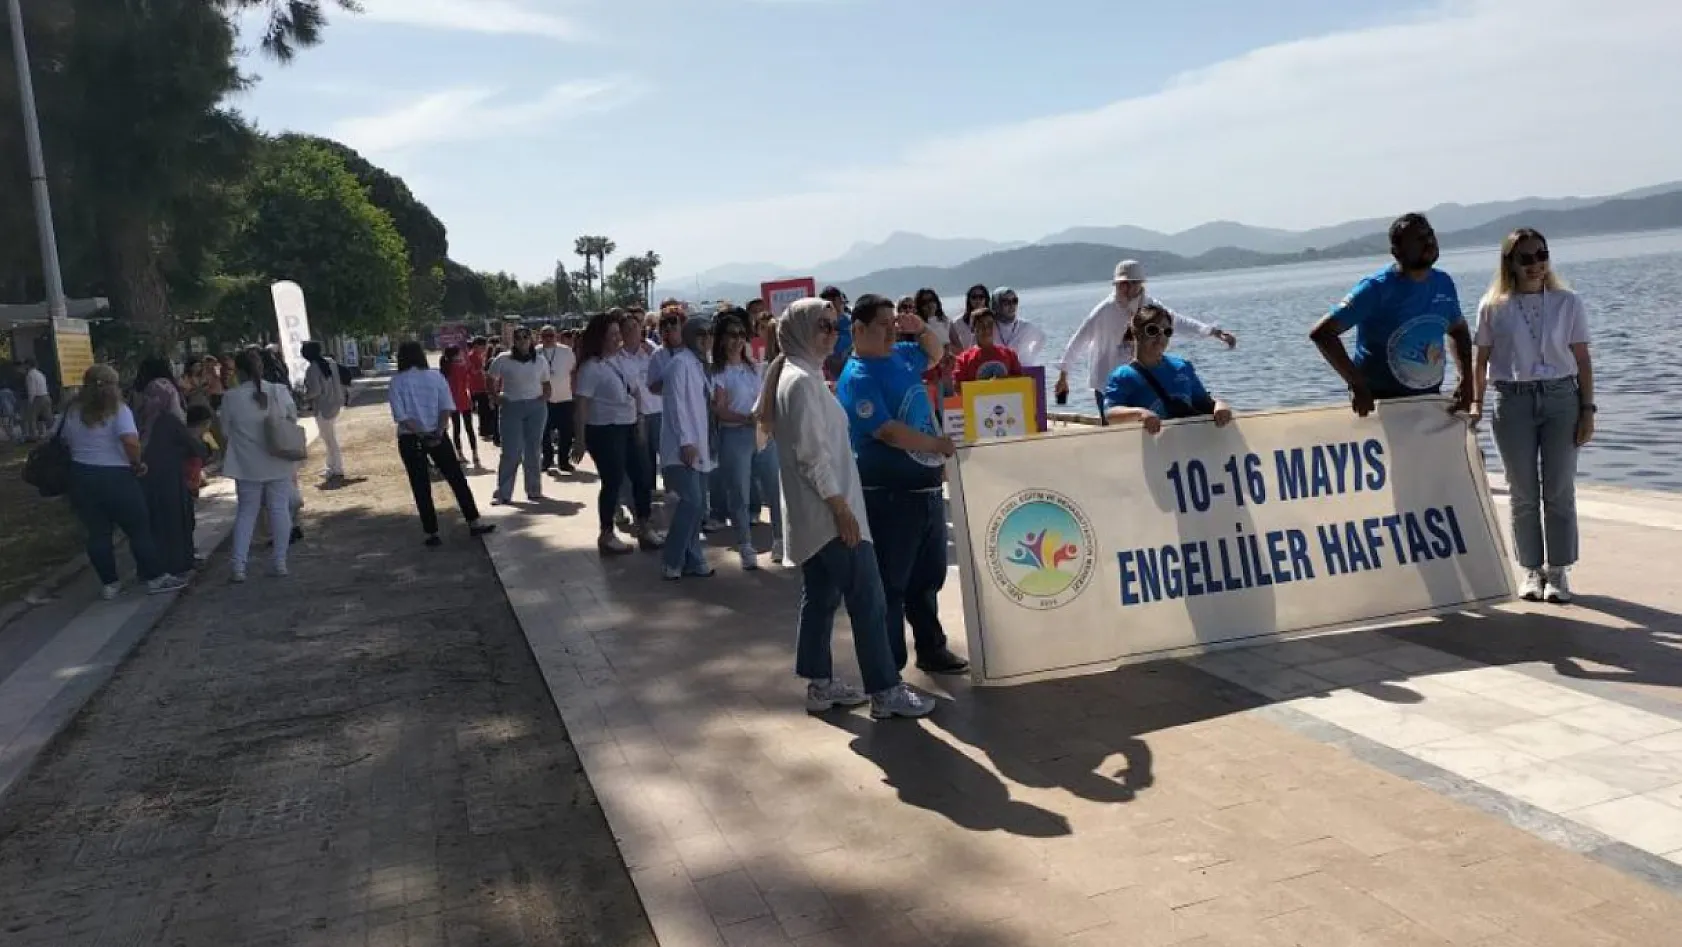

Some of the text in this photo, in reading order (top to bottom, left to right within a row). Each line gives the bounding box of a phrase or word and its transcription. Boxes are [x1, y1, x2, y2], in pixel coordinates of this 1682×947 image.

[1166, 437, 1387, 514] 10-16 MAYIS
[1117, 504, 1468, 606] ENGELLİLER HAFTASI
